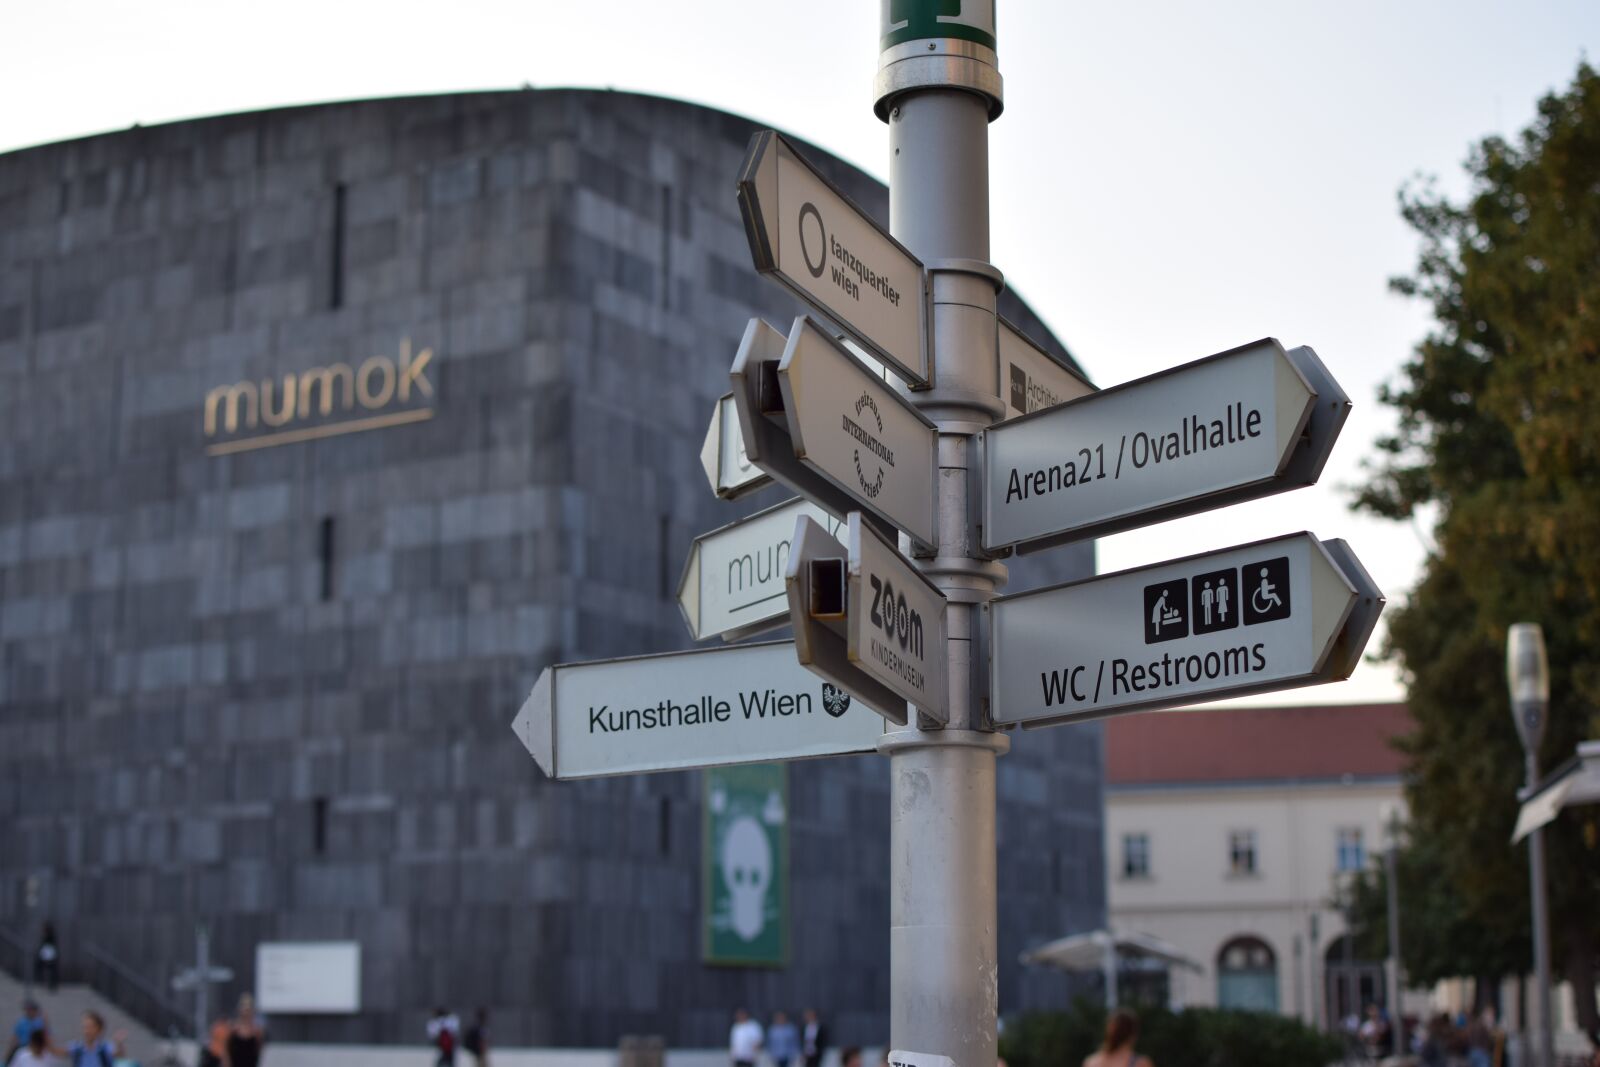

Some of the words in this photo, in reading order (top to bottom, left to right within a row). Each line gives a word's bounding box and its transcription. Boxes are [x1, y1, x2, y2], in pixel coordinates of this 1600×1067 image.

[830, 234, 900, 307] tanzquartier
[831, 265, 860, 302] wien
[203, 336, 434, 436] mumok
[855, 390, 883, 434] freiraum
[843, 414, 895, 468] INTERNATIONAL
[1006, 444, 1106, 503] Arena21
[1131, 402, 1262, 469] Ovalhalle
[854, 448, 885, 499] quartier21
[871, 638, 925, 694] KINDERMUSEUM
[1041, 664, 1086, 707] WC
[1112, 642, 1266, 695] Restrooms
[589, 696, 731, 734] Kunsthalle
[739, 688, 811, 720] Wien
